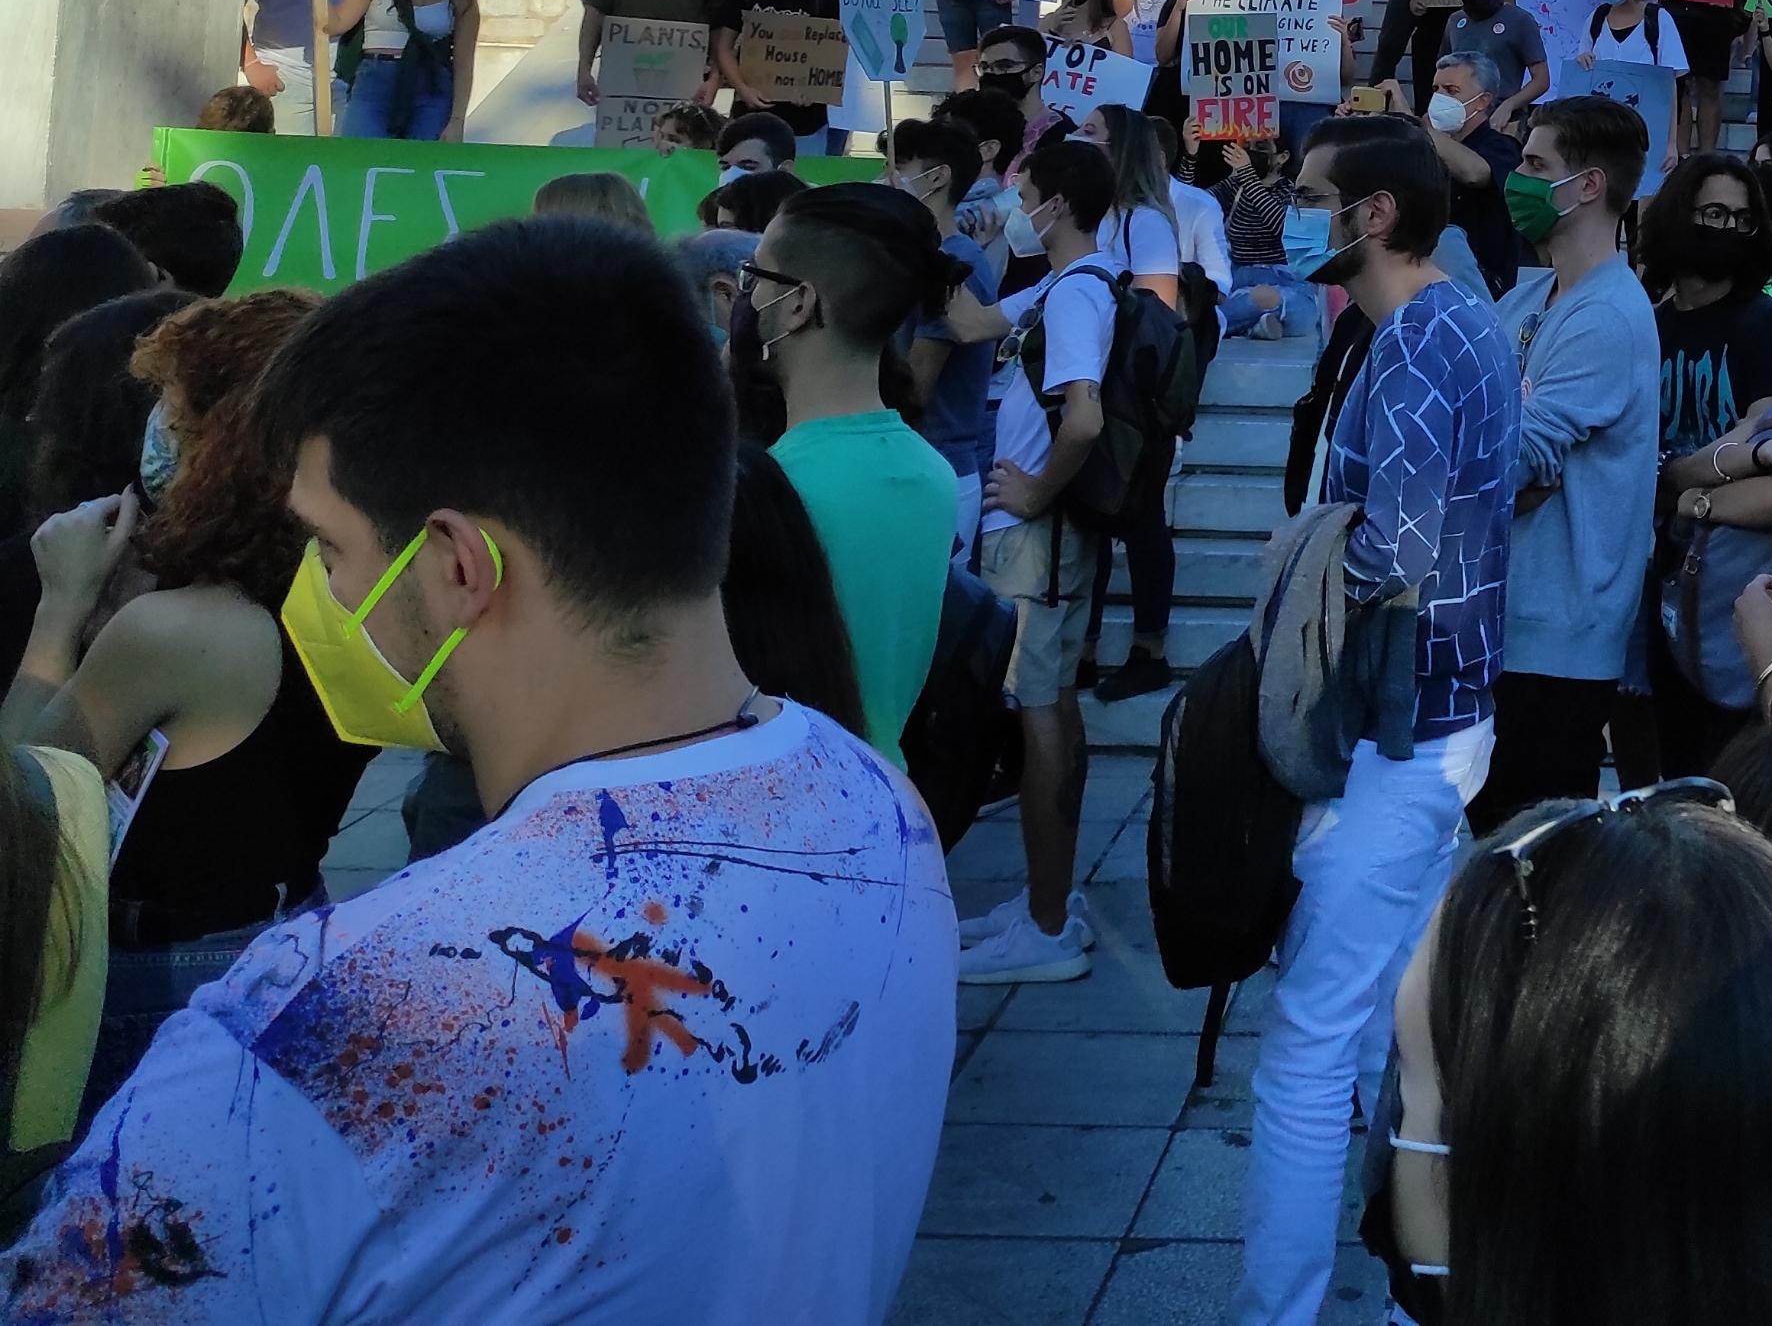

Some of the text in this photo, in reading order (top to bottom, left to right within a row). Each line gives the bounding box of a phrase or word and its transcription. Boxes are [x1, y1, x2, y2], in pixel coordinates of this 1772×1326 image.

[750, 22, 774, 40] You
[1208, 16, 1248, 40] OUR
[764, 45, 808, 64] House
[1046, 36, 1108, 72] TOP
[1191, 39, 1277, 76] HOME
[808, 67, 842, 86] HOME
[1043, 70, 1097, 96] ATE
[1215, 74, 1270, 97] IS ON
[1196, 96, 1277, 133] FIRE
